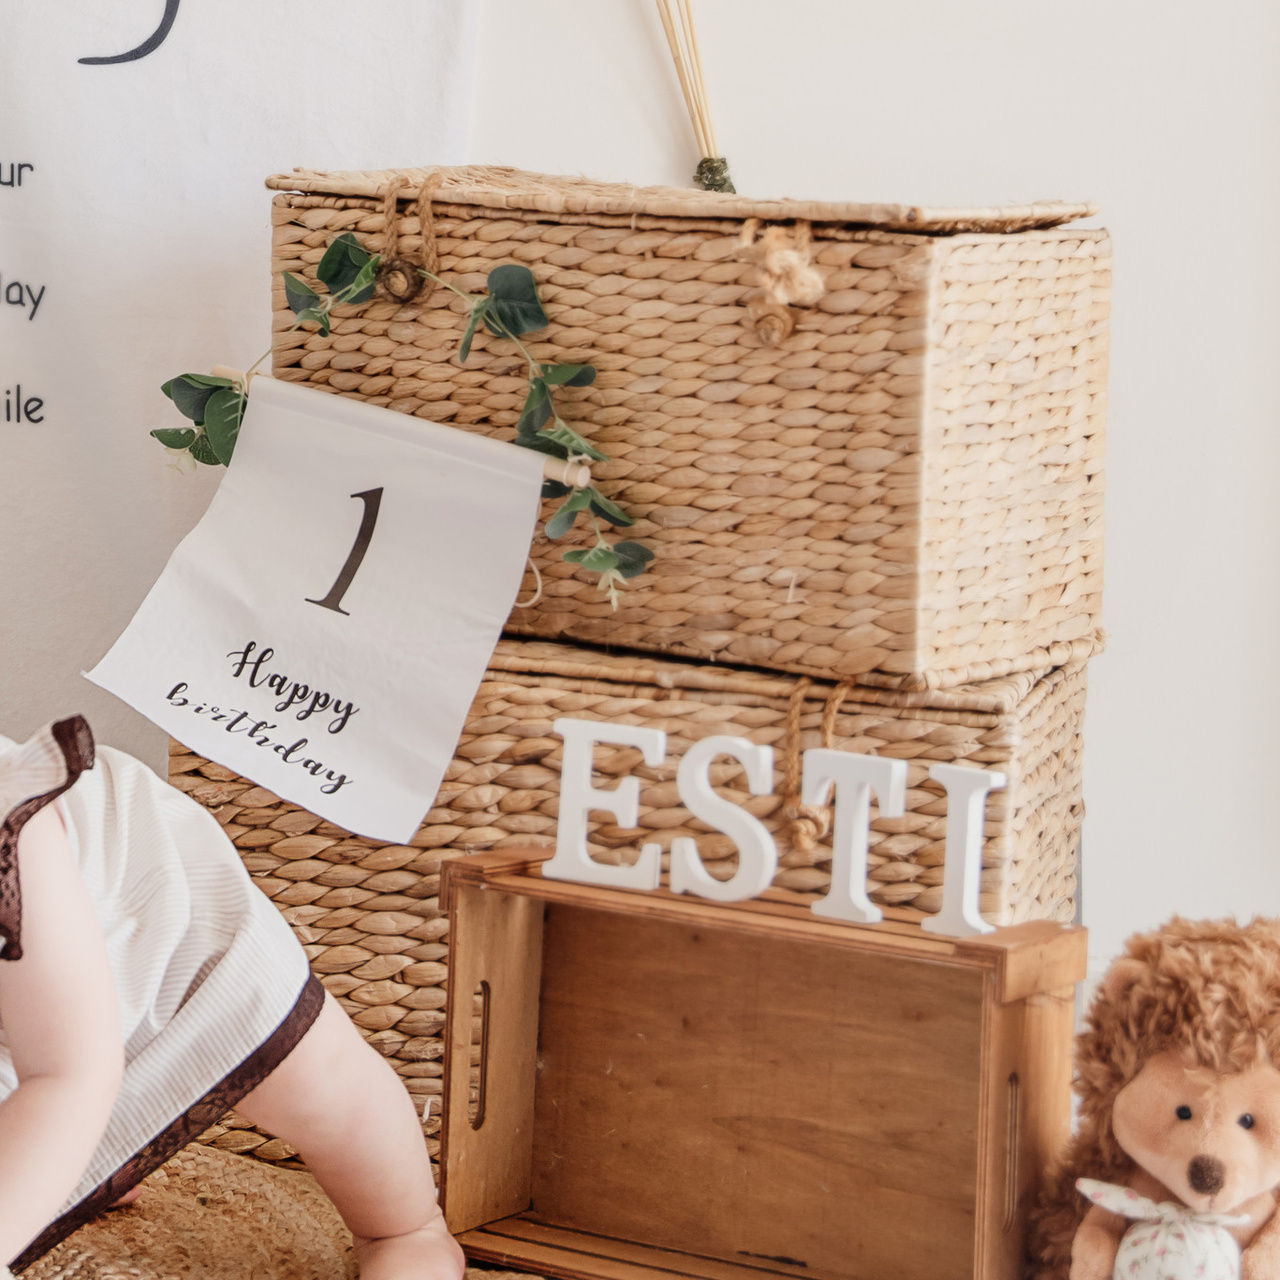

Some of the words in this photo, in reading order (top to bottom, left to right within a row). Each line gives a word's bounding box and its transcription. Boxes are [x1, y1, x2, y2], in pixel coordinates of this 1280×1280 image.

[304, 486, 385, 617] 1
[166, 682, 353, 795] birthday
[227, 641, 360, 734] Happy
[542, 717, 1007, 937] ESTI
